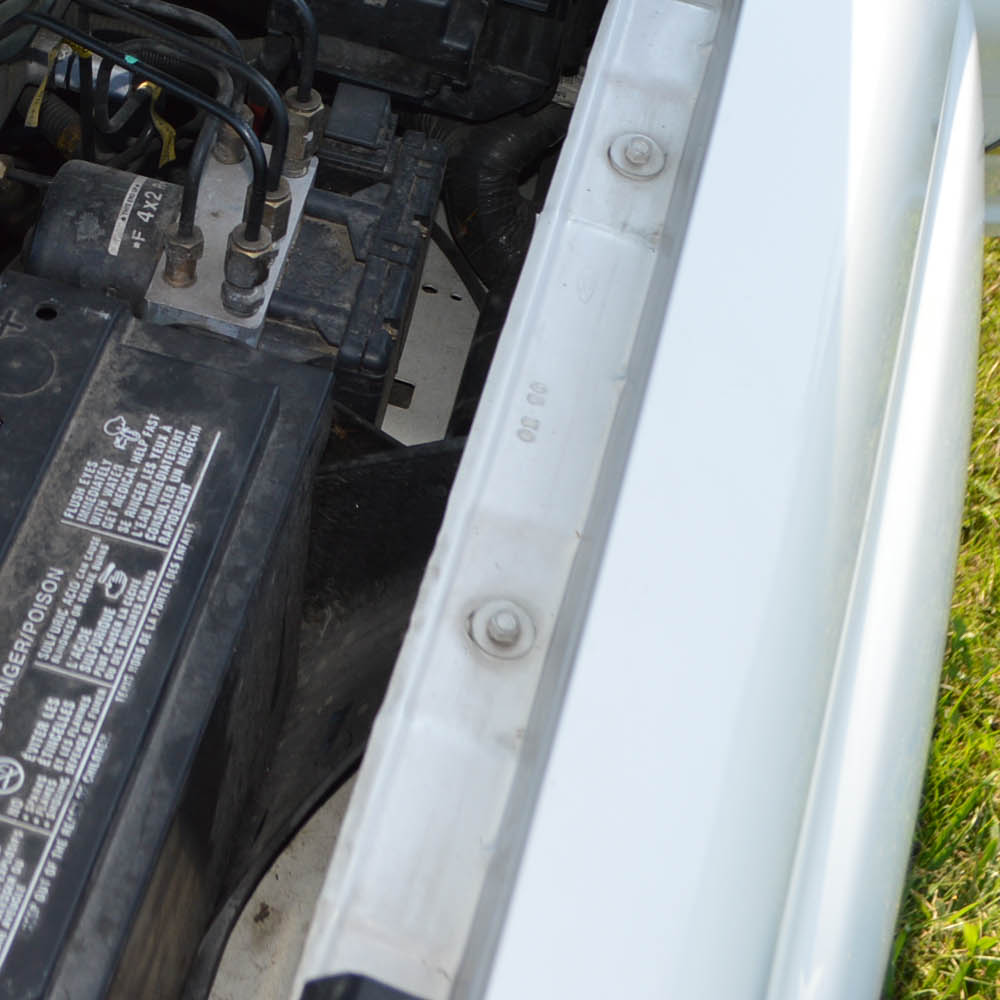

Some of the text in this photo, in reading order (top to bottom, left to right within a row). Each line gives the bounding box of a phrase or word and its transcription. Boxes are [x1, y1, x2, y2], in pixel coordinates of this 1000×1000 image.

[101, 414, 159, 529] GET MEDICAL HELP FAST
[140, 461, 156, 480] LES
[149, 434, 167, 459] YEUX
[63, 460, 97, 518] FLUSH EYES
[76, 458, 112, 522] IMMEDIATELY
[89, 463, 124, 525] WITH WATER
[124, 481, 147, 517] RINCER
[144, 484, 176, 541] CONSULTER
[169, 468, 183, 482] UN
[157, 483, 192, 544] RAPIDEMENT
[117, 519, 132, 533] SE
[130, 507, 152, 537] L'EAU
[37, 607, 68, 660] SULFURIC
[61, 580, 80, 605] ACID
[66, 627, 92, 668] L'ACIDE
[78, 606, 115, 673] SULFURIQUE
[19, 695, 60, 762] ÉVITER LES
